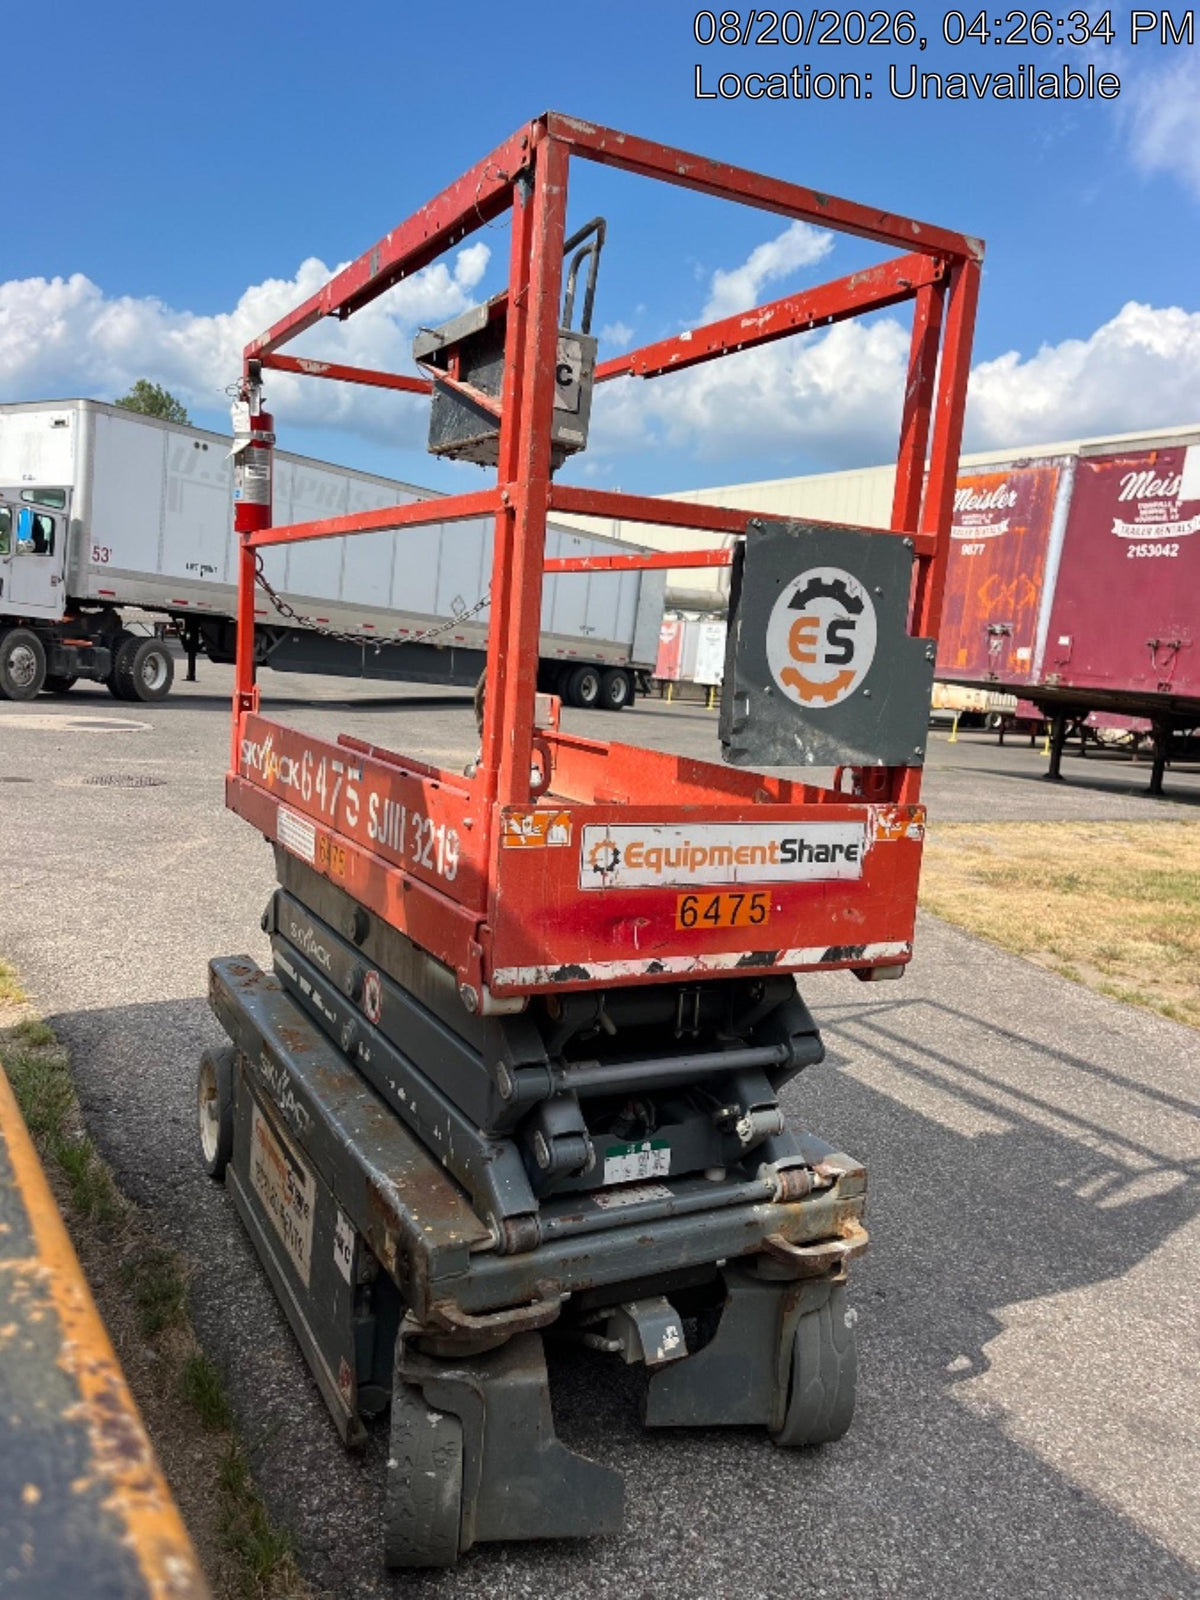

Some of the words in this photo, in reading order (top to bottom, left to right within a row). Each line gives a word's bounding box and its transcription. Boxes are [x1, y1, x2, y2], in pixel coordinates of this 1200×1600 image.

[953, 483, 1018, 512] Meisler
[92, 545, 112, 563] 53'
[1126, 543, 1180, 558] 2153042
[788, 616, 856, 665] ES
[301, 750, 361, 828] 6475
[412, 812, 460, 881] 3219
[623, 838, 859, 874] EquipmentShare
[680, 893, 767, 928] 6475
